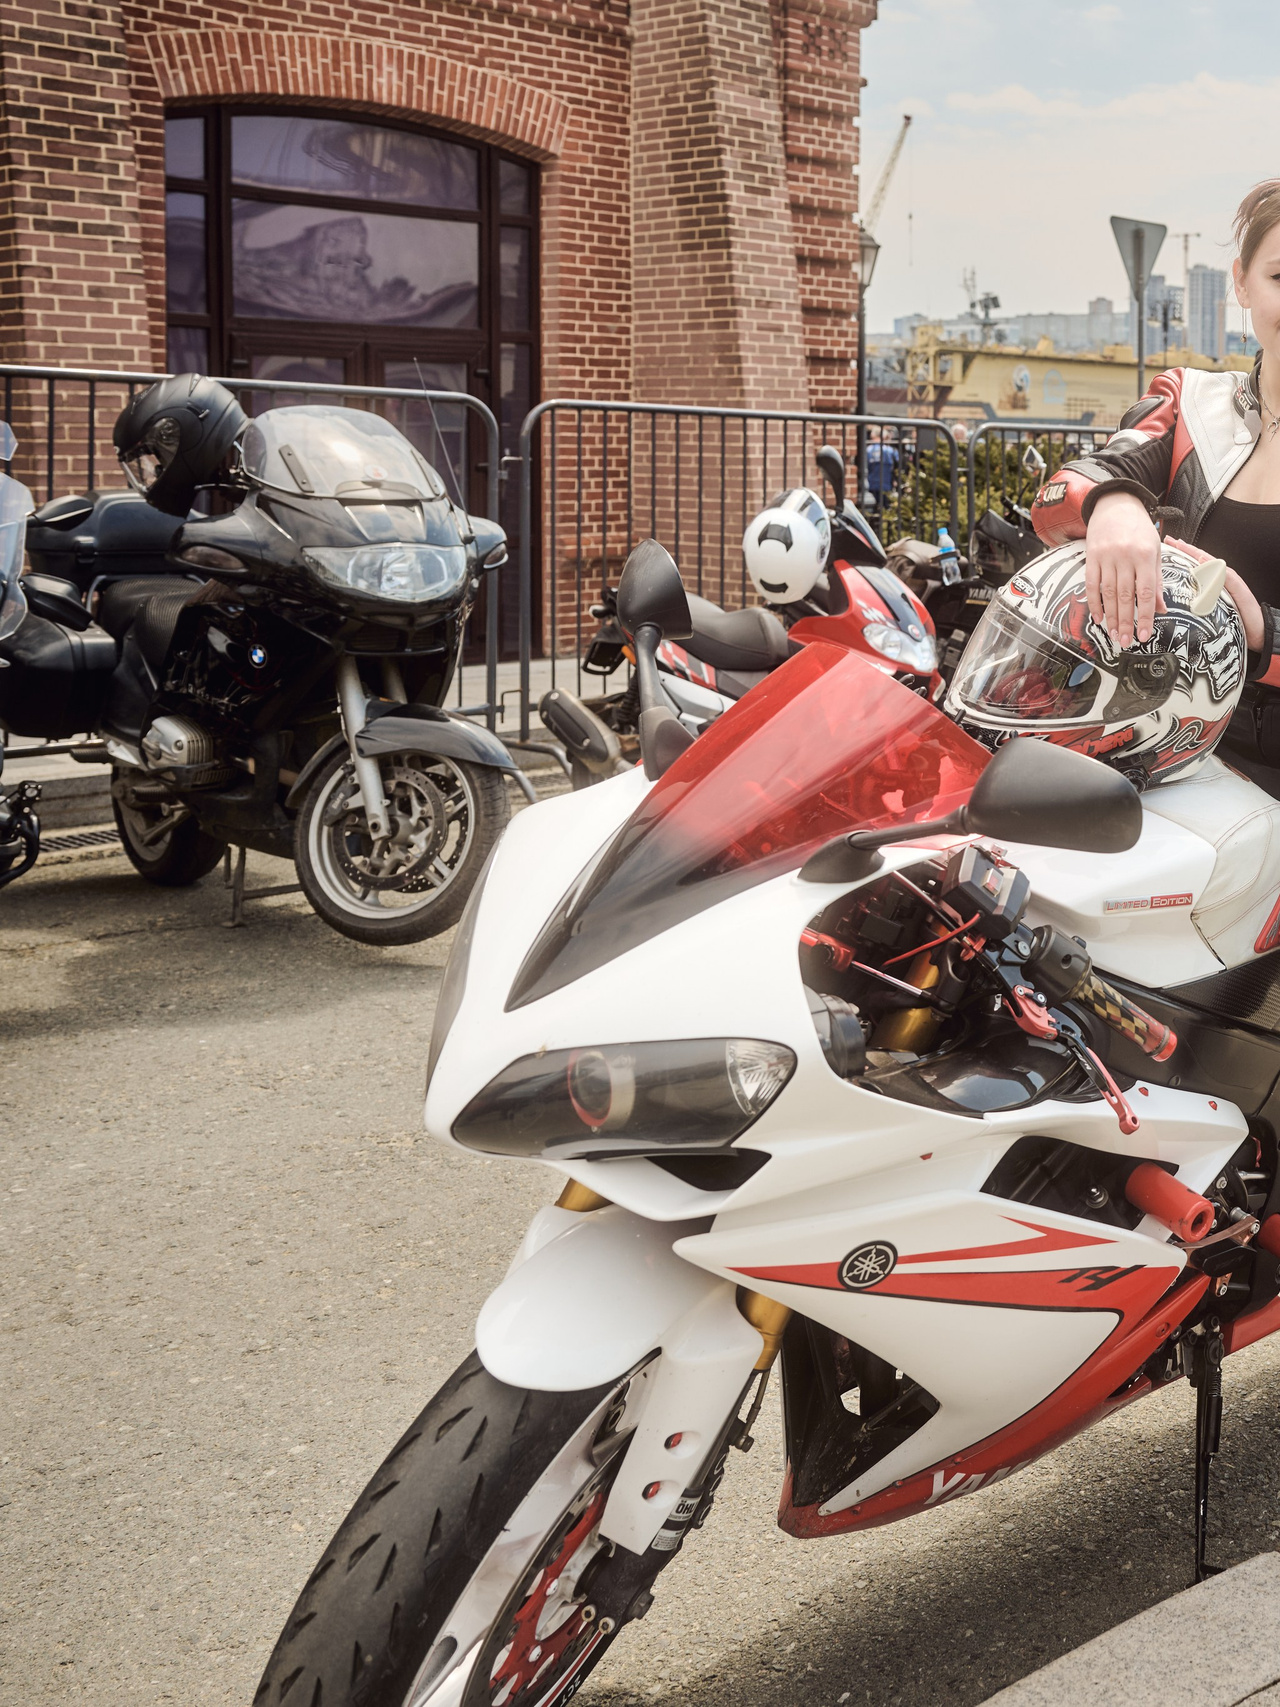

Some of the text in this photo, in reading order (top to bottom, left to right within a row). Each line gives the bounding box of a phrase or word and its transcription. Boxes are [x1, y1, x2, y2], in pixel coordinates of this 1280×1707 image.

[968, 587, 997, 600] YAMA
[1106, 896, 1192, 911] LIMITED EDITION
